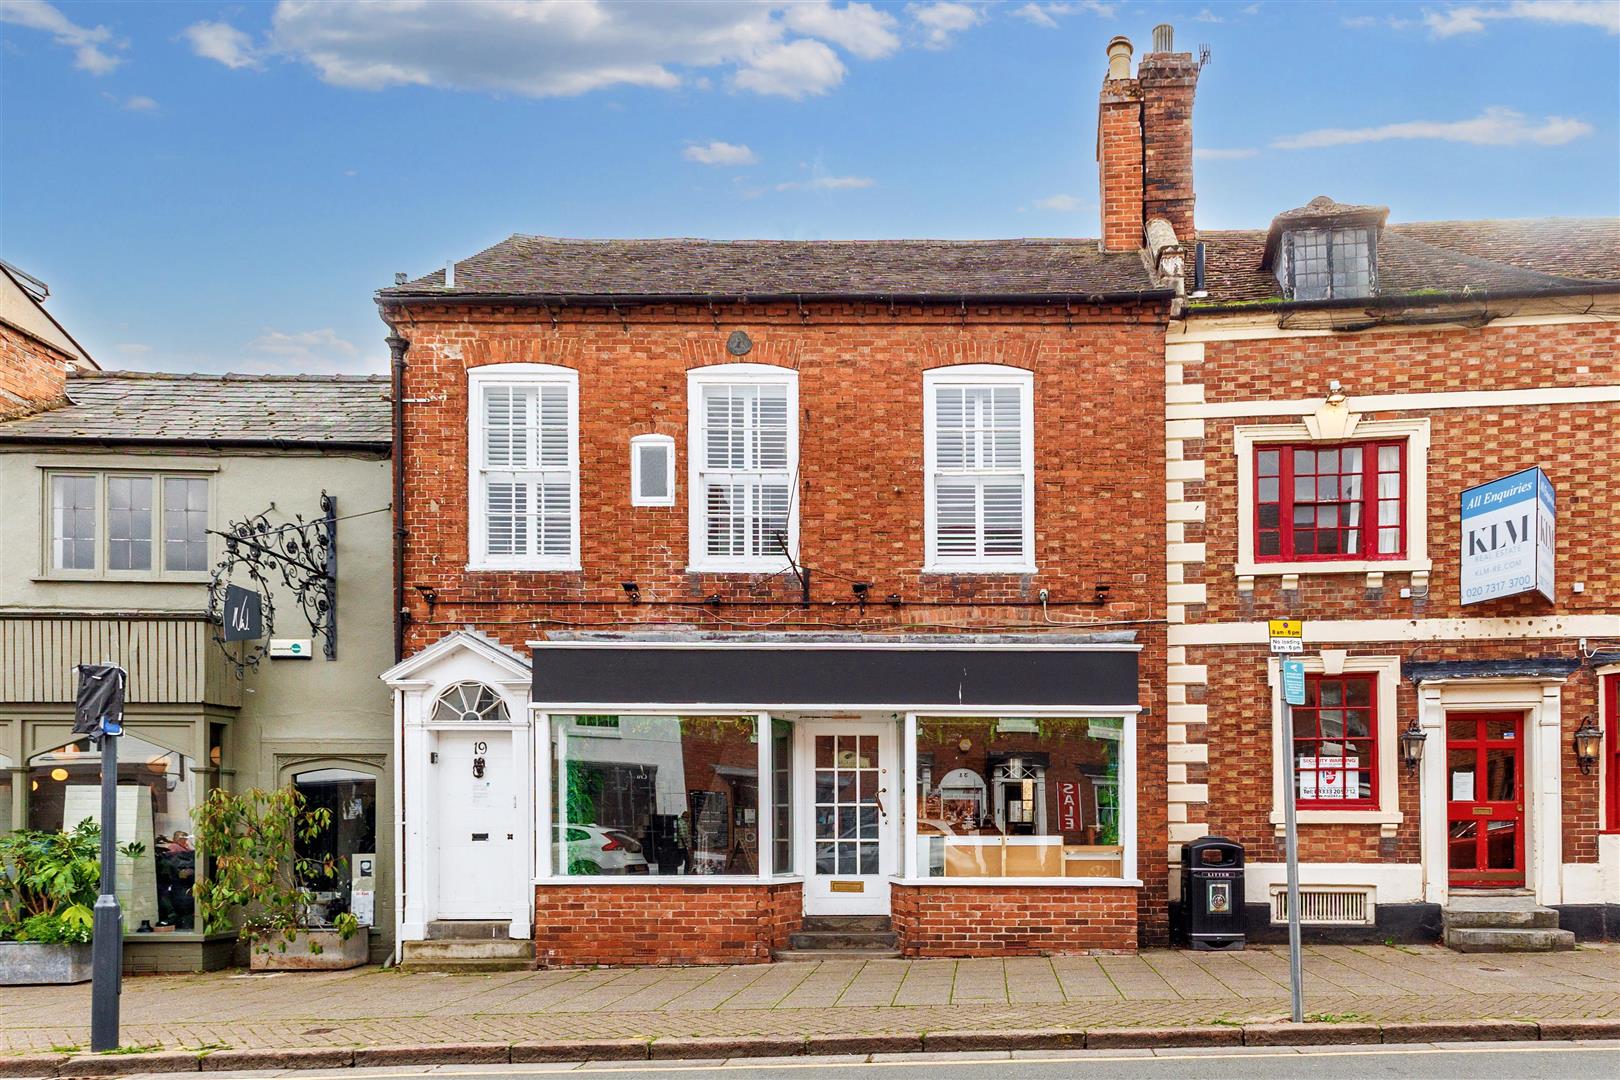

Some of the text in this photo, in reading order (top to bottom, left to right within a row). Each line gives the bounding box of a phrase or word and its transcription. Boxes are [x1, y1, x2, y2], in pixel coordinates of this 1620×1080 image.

[1467, 495, 1482, 509] All
[1484, 481, 1533, 504] Enquiries
[1469, 515, 1528, 556] KLM
[1474, 545, 1521, 562] REAL ESTATE
[1466, 586, 1483, 598] 020
[1485, 581, 1506, 593] 7317
[1509, 575, 1531, 588] 3700
[474, 742, 488, 755] 19
